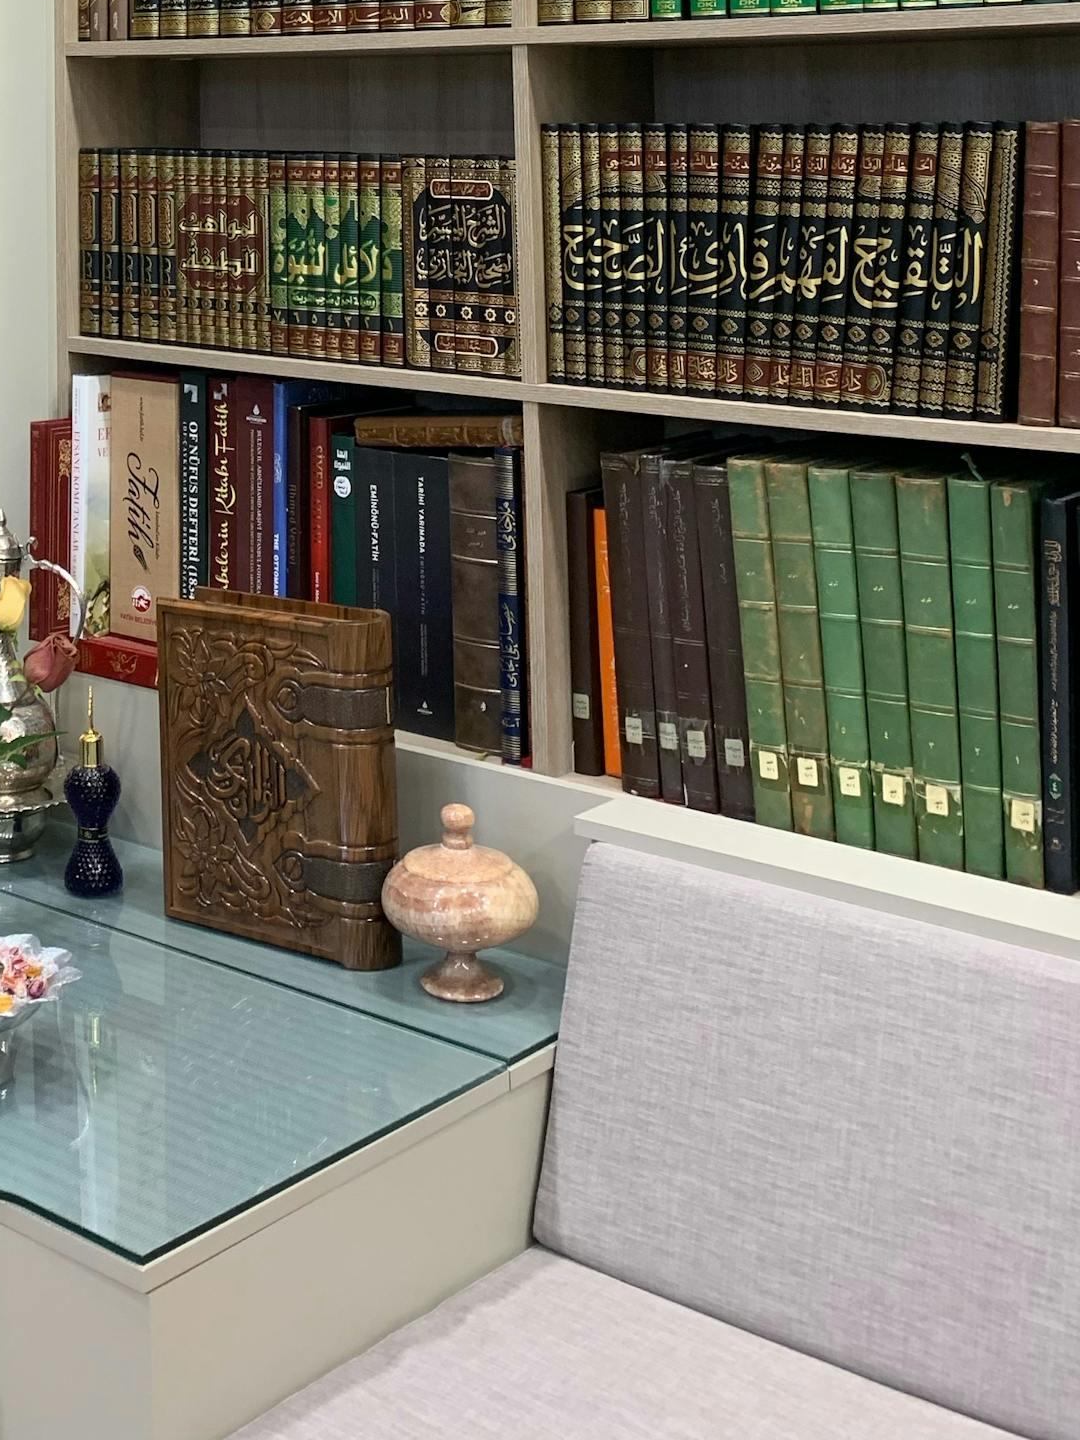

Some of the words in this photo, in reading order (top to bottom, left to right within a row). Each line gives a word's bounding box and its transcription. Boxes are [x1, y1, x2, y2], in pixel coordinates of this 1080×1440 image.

[282, 9, 342, 25] الإسلامية
[350, 7, 409, 23] البشائر
[417, 10, 433, 23] دار
[656, 0, 677, 11] DKI
[419, 204, 468, 244] الميسر
[467, 203, 507, 248] الشرح
[273, 229, 329, 285] النبوة
[335, 241, 393, 287] دلائل
[416, 245, 473, 283] البخاري
[473, 251, 512, 288] لصحيح
[563, 216, 677, 297] الصحيح
[749, 223, 849, 303] لفهم
[852, 224, 984, 310] التلقيح
[842, 365, 862, 390] دار
[188, 421, 199, 442] OF
[214, 402, 236, 455] Fatih
[188, 445, 201, 494] NÜFUS
[214, 456, 236, 516] Kitabı
[122, 451, 160, 550] Fatih
[370, 484, 380, 561] EMİNÖNÜ-FATİH
[188, 497, 201, 562] DEFTERİ
[418, 508, 426, 554] YARIMADA
